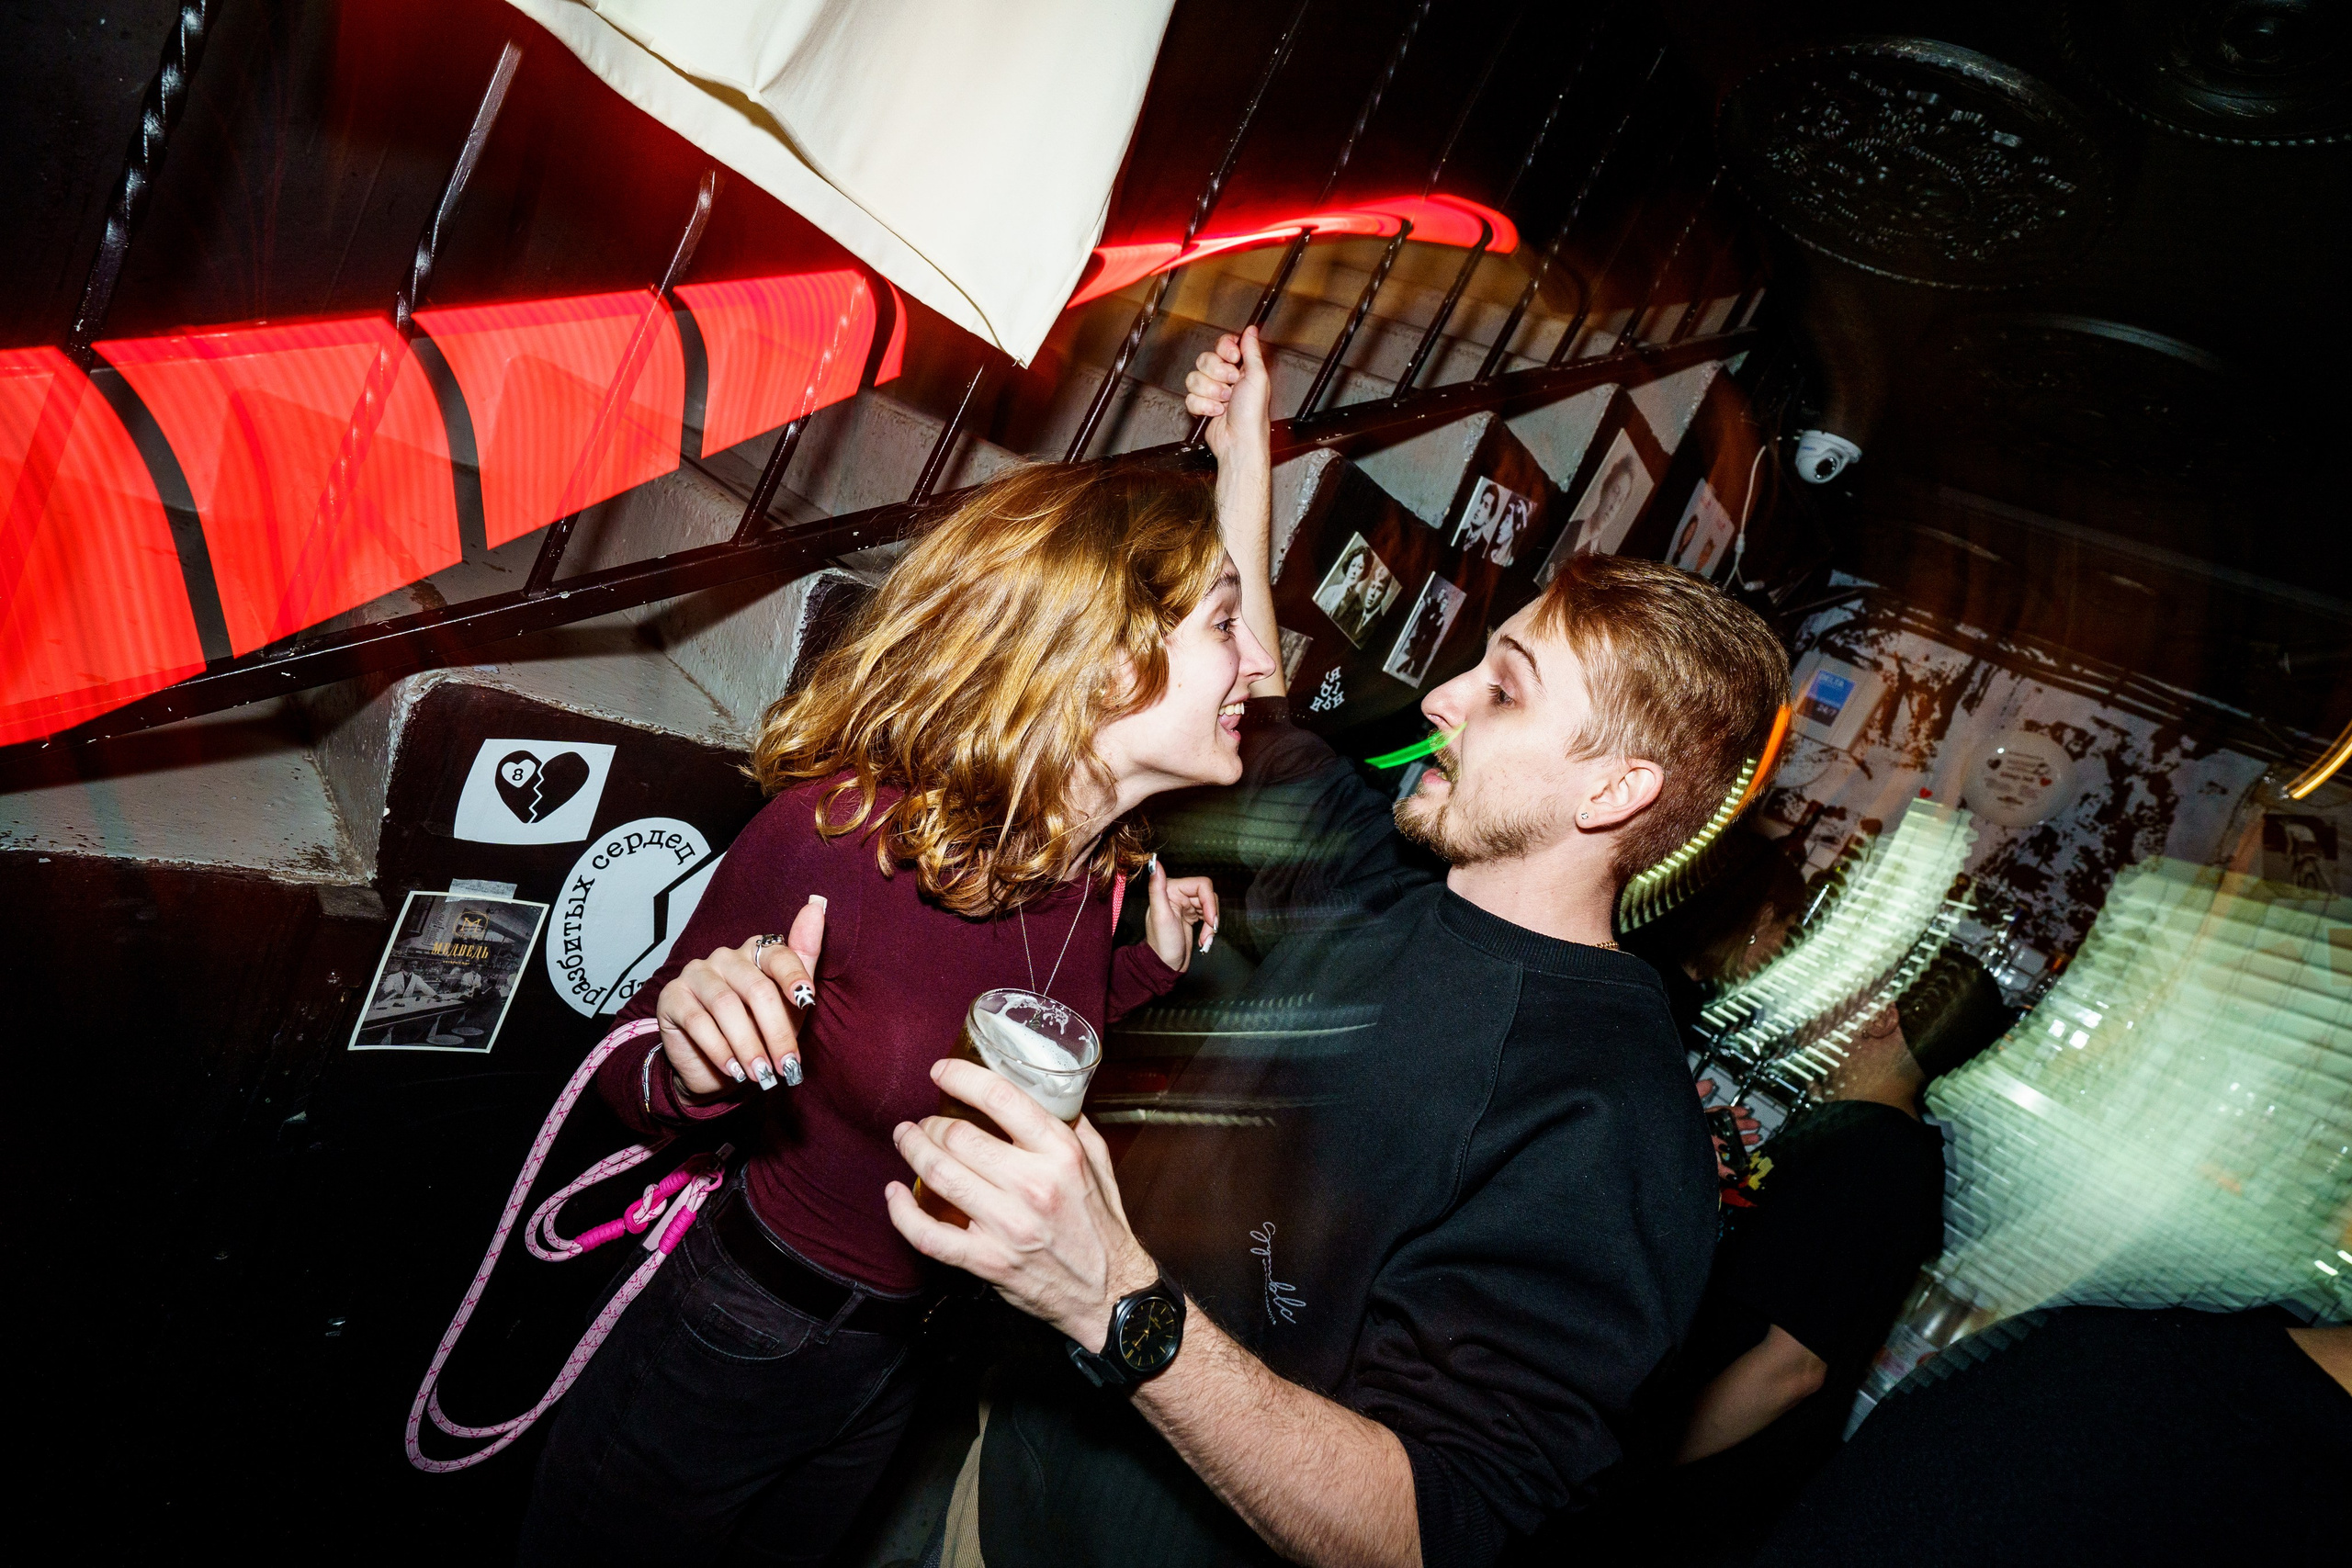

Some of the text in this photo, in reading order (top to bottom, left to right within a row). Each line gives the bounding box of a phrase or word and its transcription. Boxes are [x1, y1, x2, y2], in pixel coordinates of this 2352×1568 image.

[512, 768, 524, 781] 8
[557, 874, 607, 1005] разбитых
[431, 942, 490, 961] МЕДВЕДЬ
